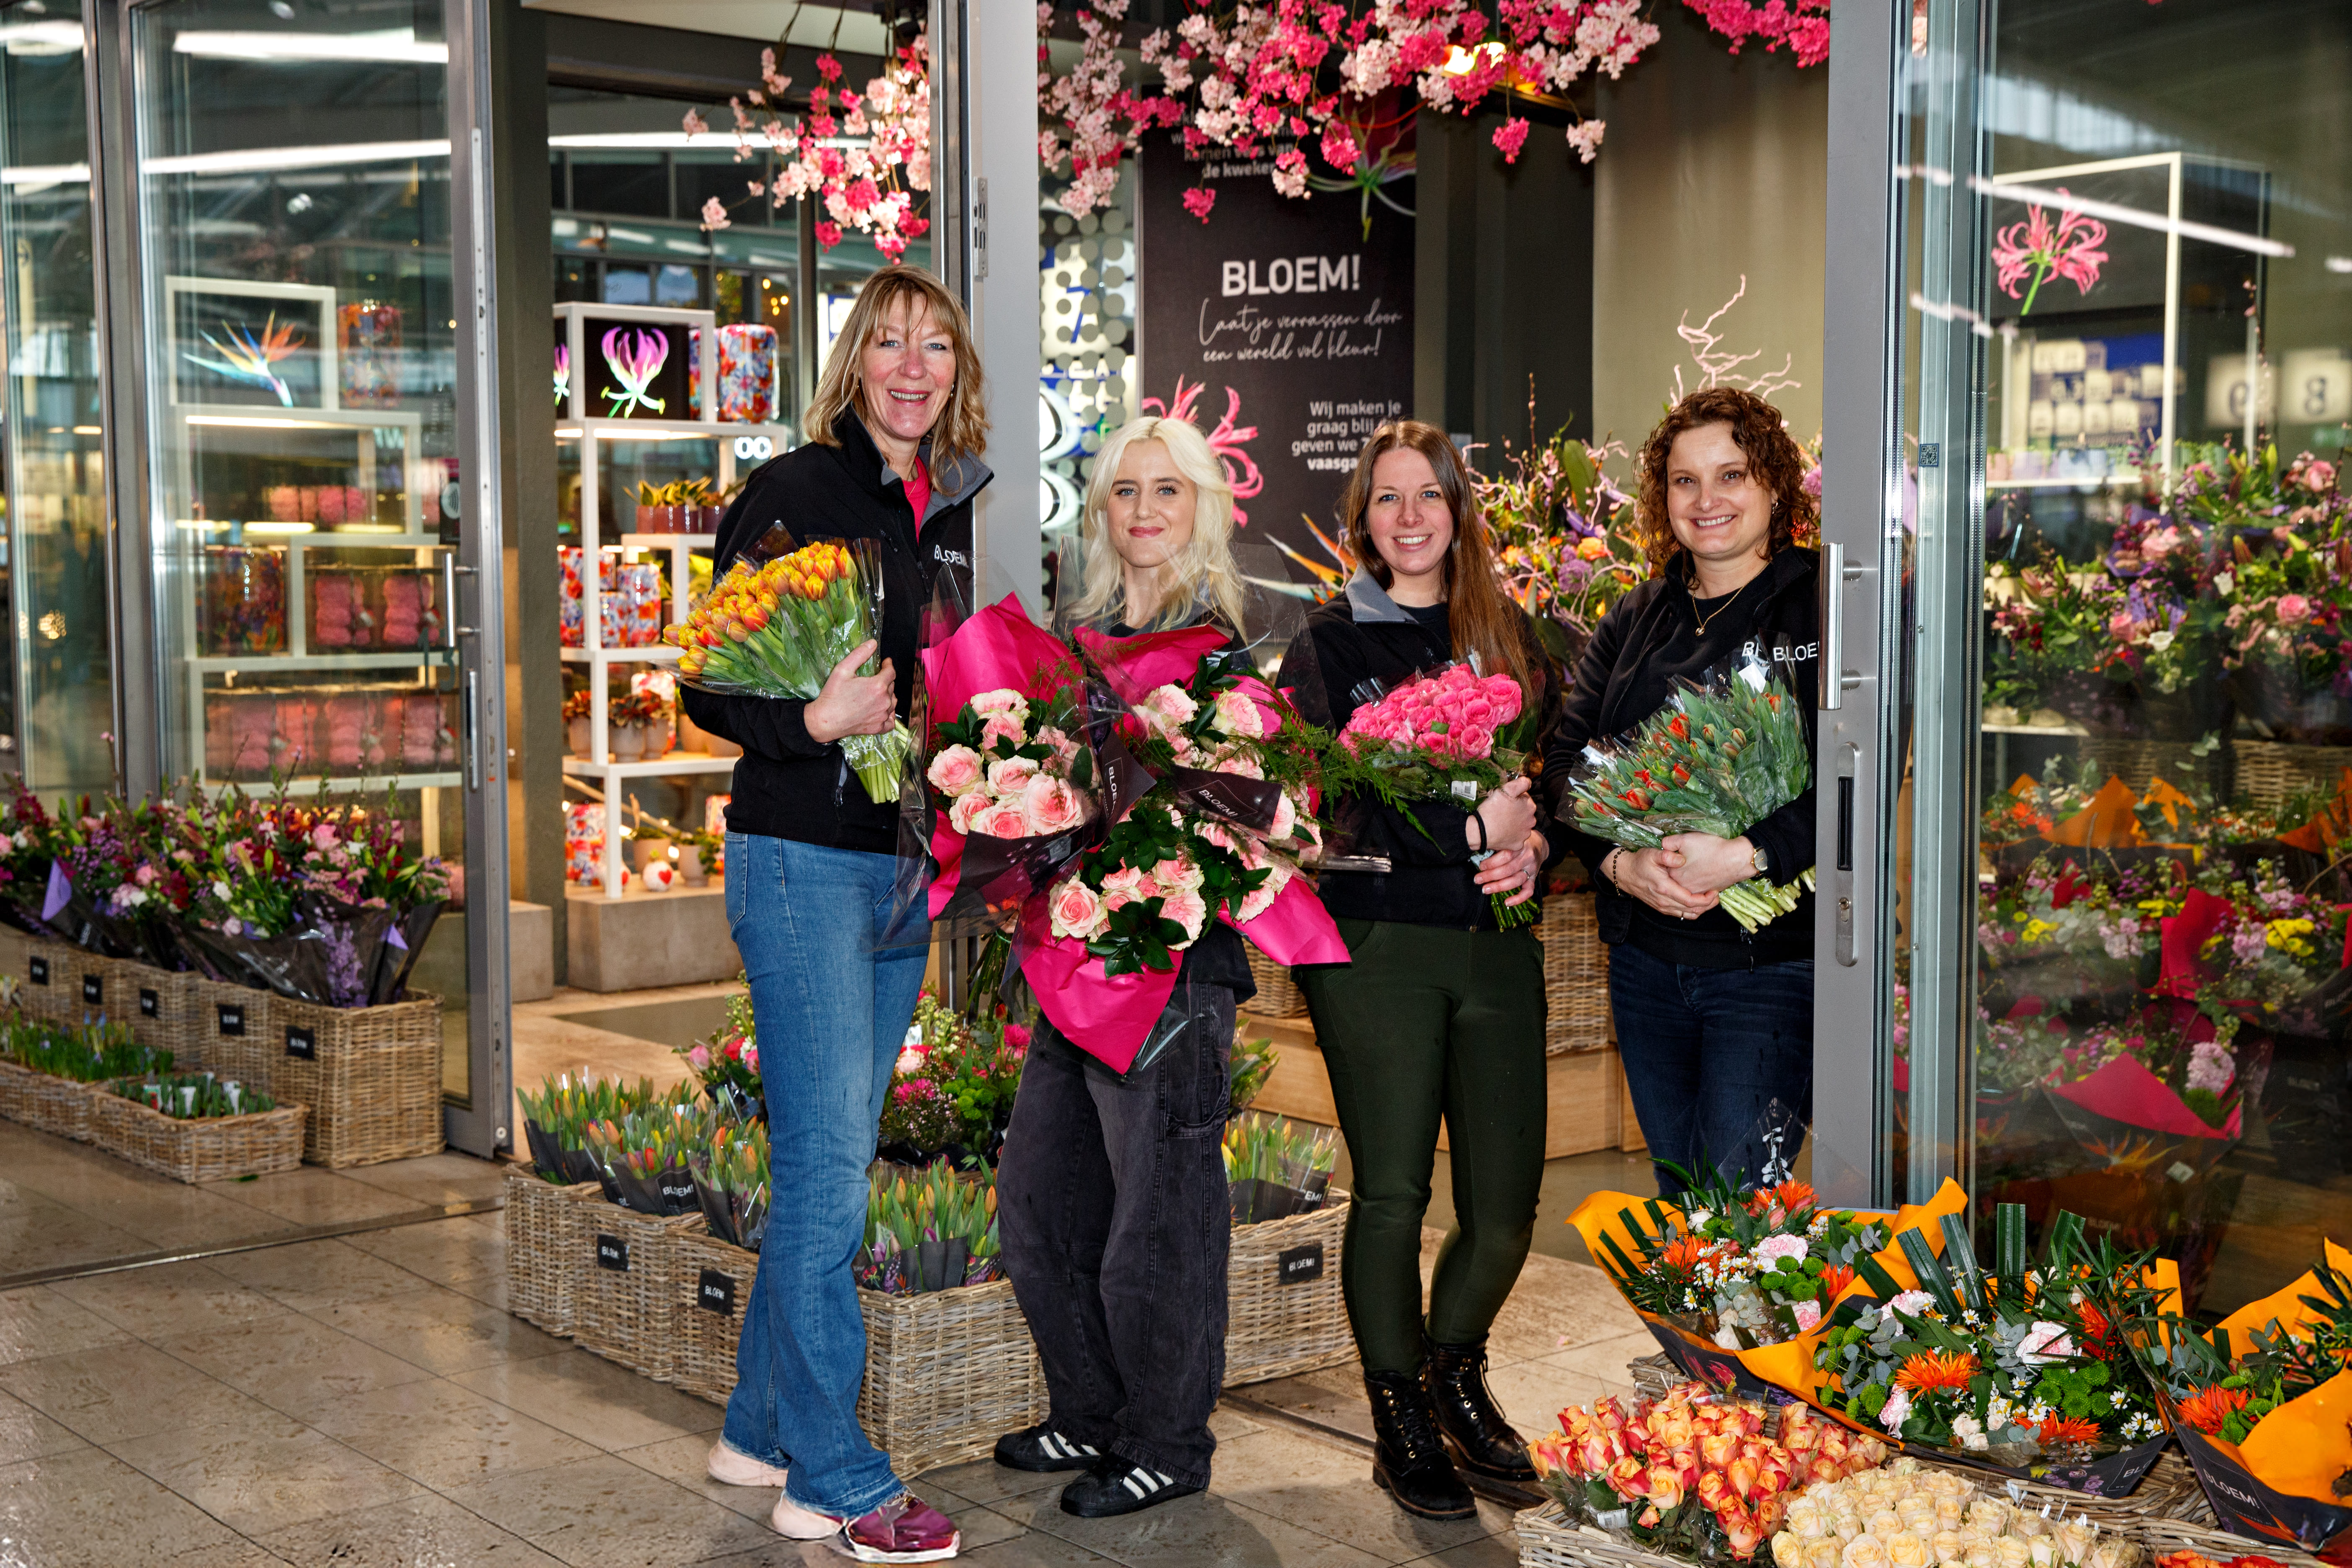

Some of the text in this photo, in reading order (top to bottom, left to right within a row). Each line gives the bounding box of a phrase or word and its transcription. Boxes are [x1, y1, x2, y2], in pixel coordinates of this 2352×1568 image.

[1203, 162, 1220, 179] de
[1221, 254, 1361, 297] BLOEM!
[1199, 297, 1259, 346] Laat
[1277, 313, 1360, 329] verrassen
[1363, 297, 1403, 326] door
[1203, 327, 1382, 363] een wereld vol kleur!
[1309, 399, 1402, 419] Wij maken je
[1306, 421, 1348, 438] graag
[1351, 417, 1375, 435] blij
[1291, 439, 1334, 457] geven
[1337, 439, 1358, 452] we
[1772, 641, 1819, 662] BLOE
[1198, 789, 1239, 817] BLOEM!
[1302, 1190, 1322, 1202] EM!
[1288, 1257, 1315, 1272] BLOEM!
[2203, 1468, 2260, 1509] BLOEM!
